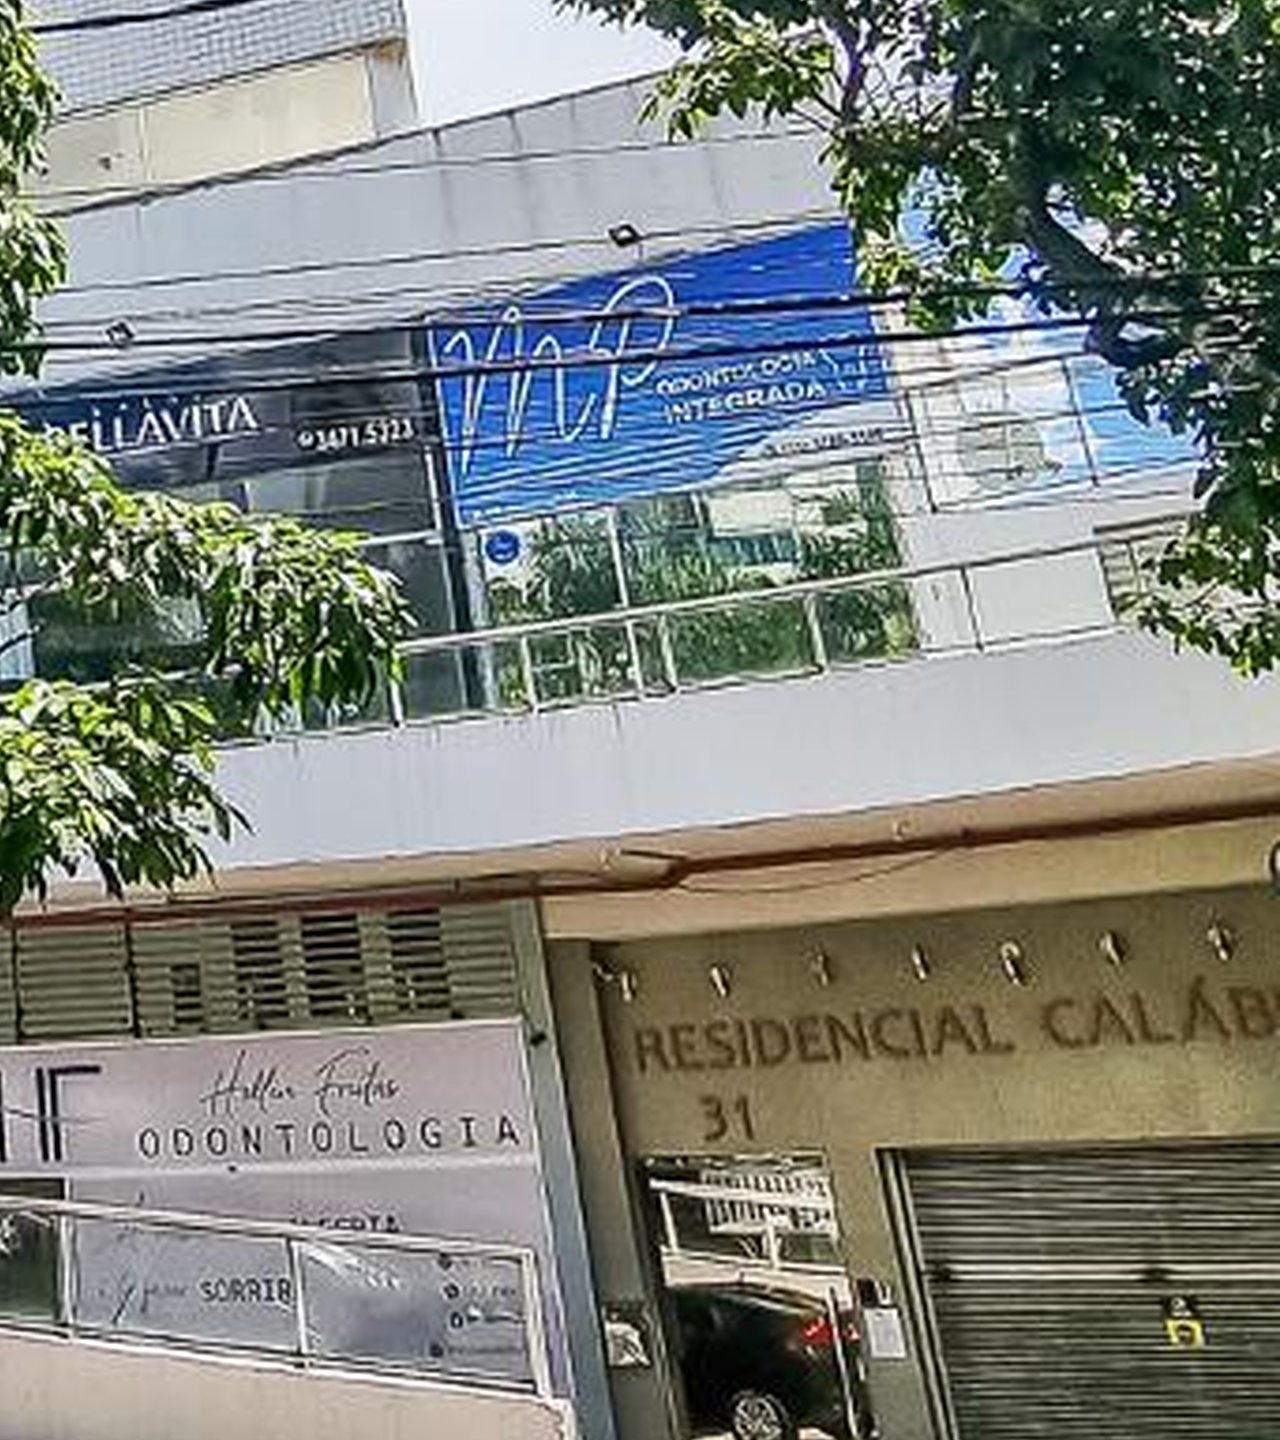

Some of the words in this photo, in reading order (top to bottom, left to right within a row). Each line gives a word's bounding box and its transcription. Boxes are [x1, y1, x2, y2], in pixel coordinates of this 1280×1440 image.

[664, 379, 828, 426] INTEGRADA
[633, 1004, 1015, 1073] RESIDENCIAL
[1042, 974, 1280, 1049] CALÁB
[138, 1114, 520, 1158] ODONTOLOGIA
[701, 1095, 753, 1144] 31
